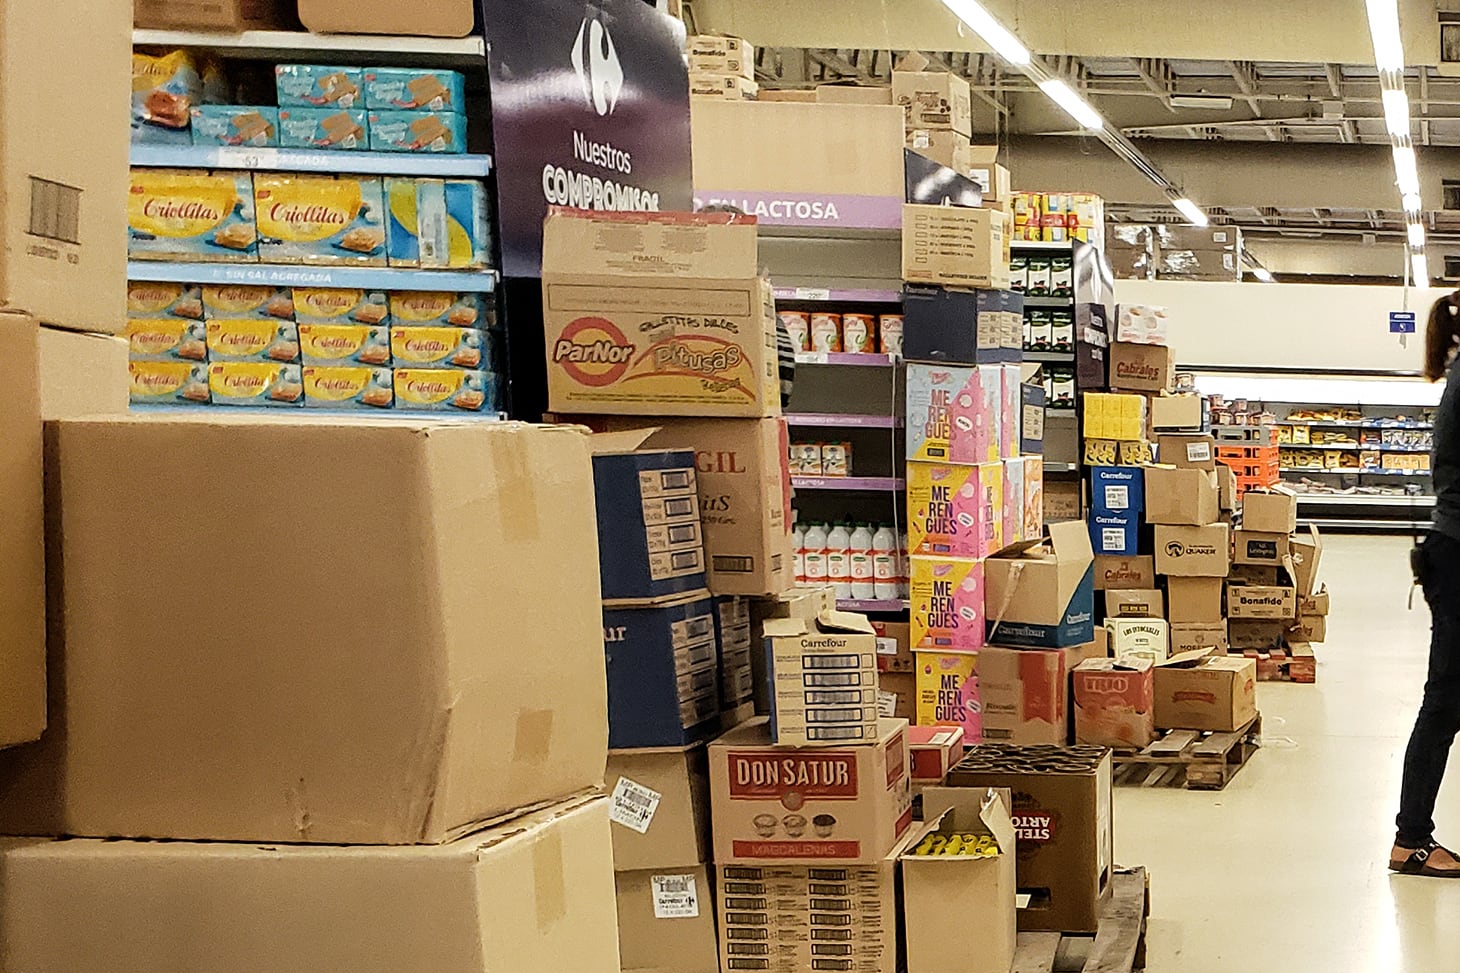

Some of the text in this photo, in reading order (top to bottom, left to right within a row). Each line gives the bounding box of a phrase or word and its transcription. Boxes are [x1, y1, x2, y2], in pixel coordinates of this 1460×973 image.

[573, 129, 632, 174] Nuestros
[143, 199, 220, 221] Criollitas
[270, 201, 347, 225] Criollitas
[742, 199, 839, 219] LACTOSA
[553, 340, 636, 364] ParNor
[930, 389, 951, 406] ME
[927, 405, 953, 423] REN
[924, 423, 957, 441] GUES
[931, 485, 951, 502] ME
[928, 502, 954, 518] REN
[925, 519, 958, 535] GUES
[933, 581, 952, 597] ME
[930, 597, 955, 613] REN
[927, 613, 959, 629] GUES
[800, 638, 848, 649] Carrefour
[940, 675, 960, 690] ME
[938, 690, 962, 706] REN
[935, 706, 966, 722] GUES
[736, 758, 850, 787] DON SATUR
